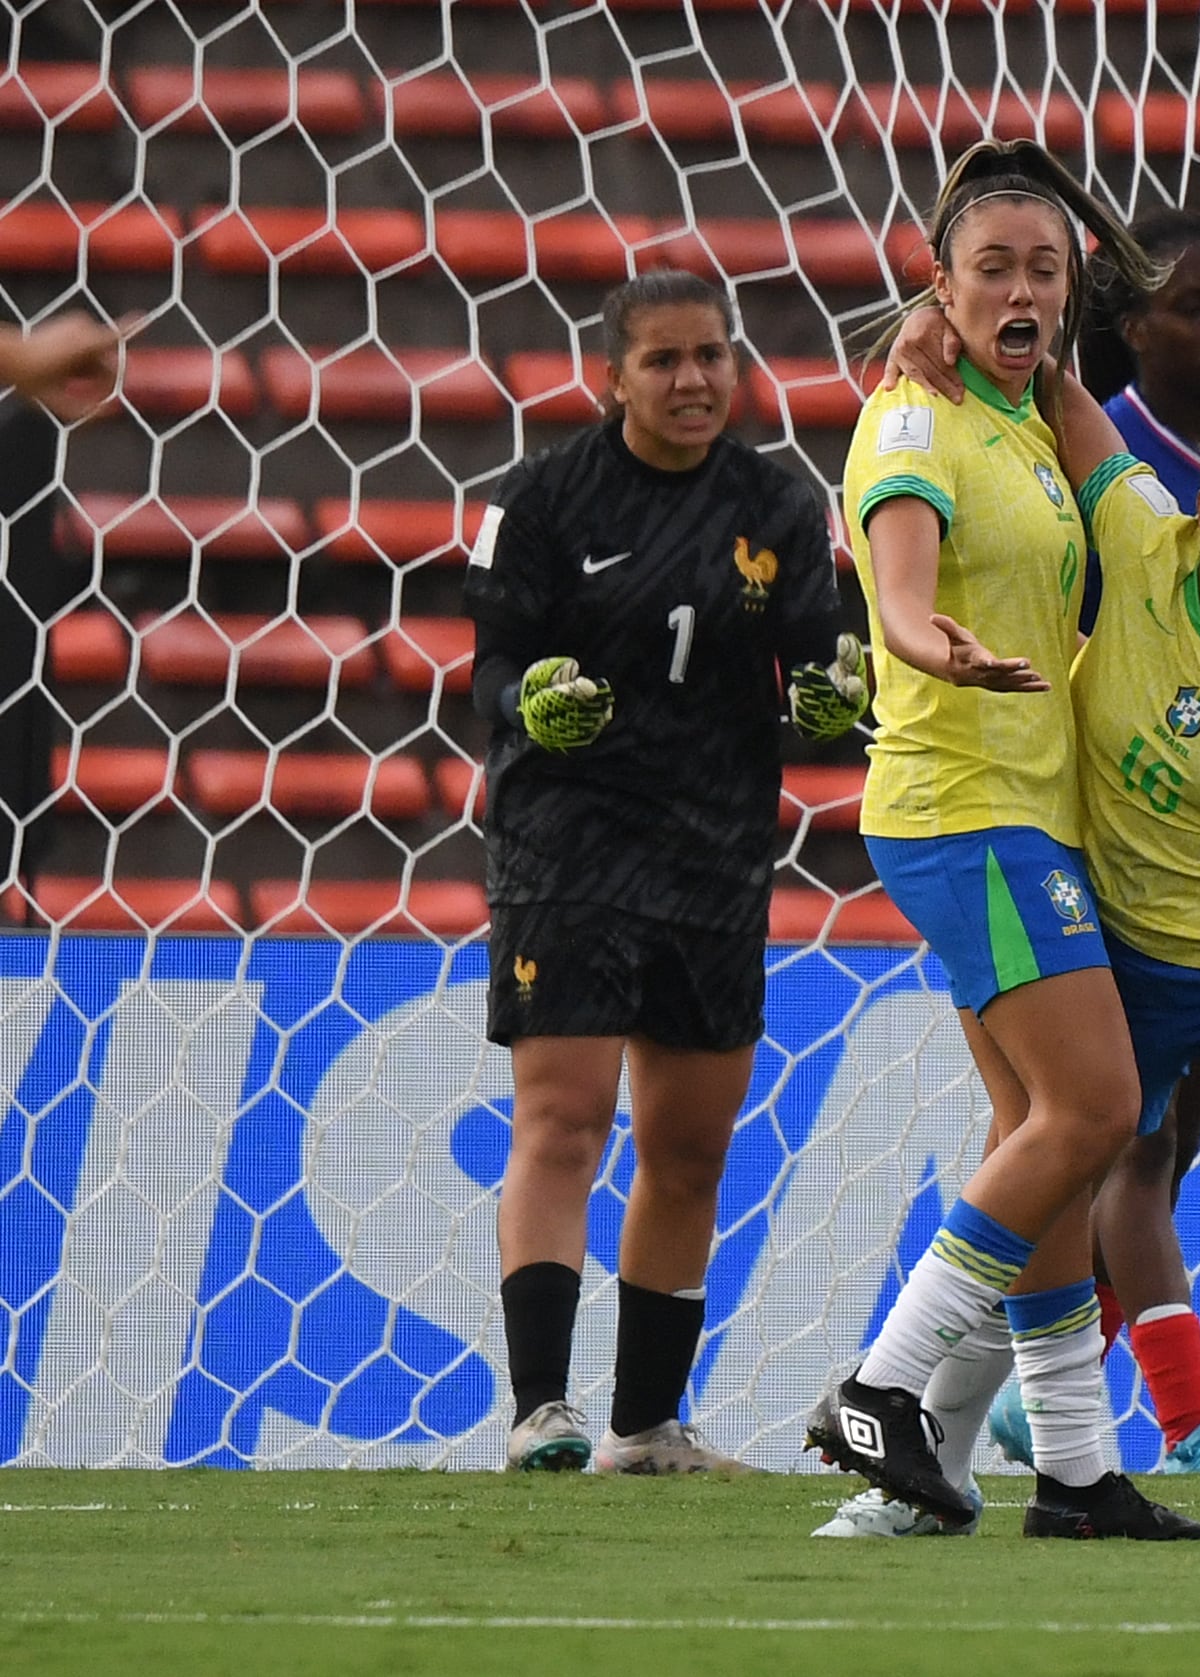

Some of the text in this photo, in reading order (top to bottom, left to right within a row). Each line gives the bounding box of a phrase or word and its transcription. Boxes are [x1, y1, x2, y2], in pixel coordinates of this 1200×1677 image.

[668, 605, 695, 684] 1
[1153, 724, 1191, 760] BRASIL
[1062, 922, 1097, 937] BRASIL
[0, 977, 1125, 1474] ISA
